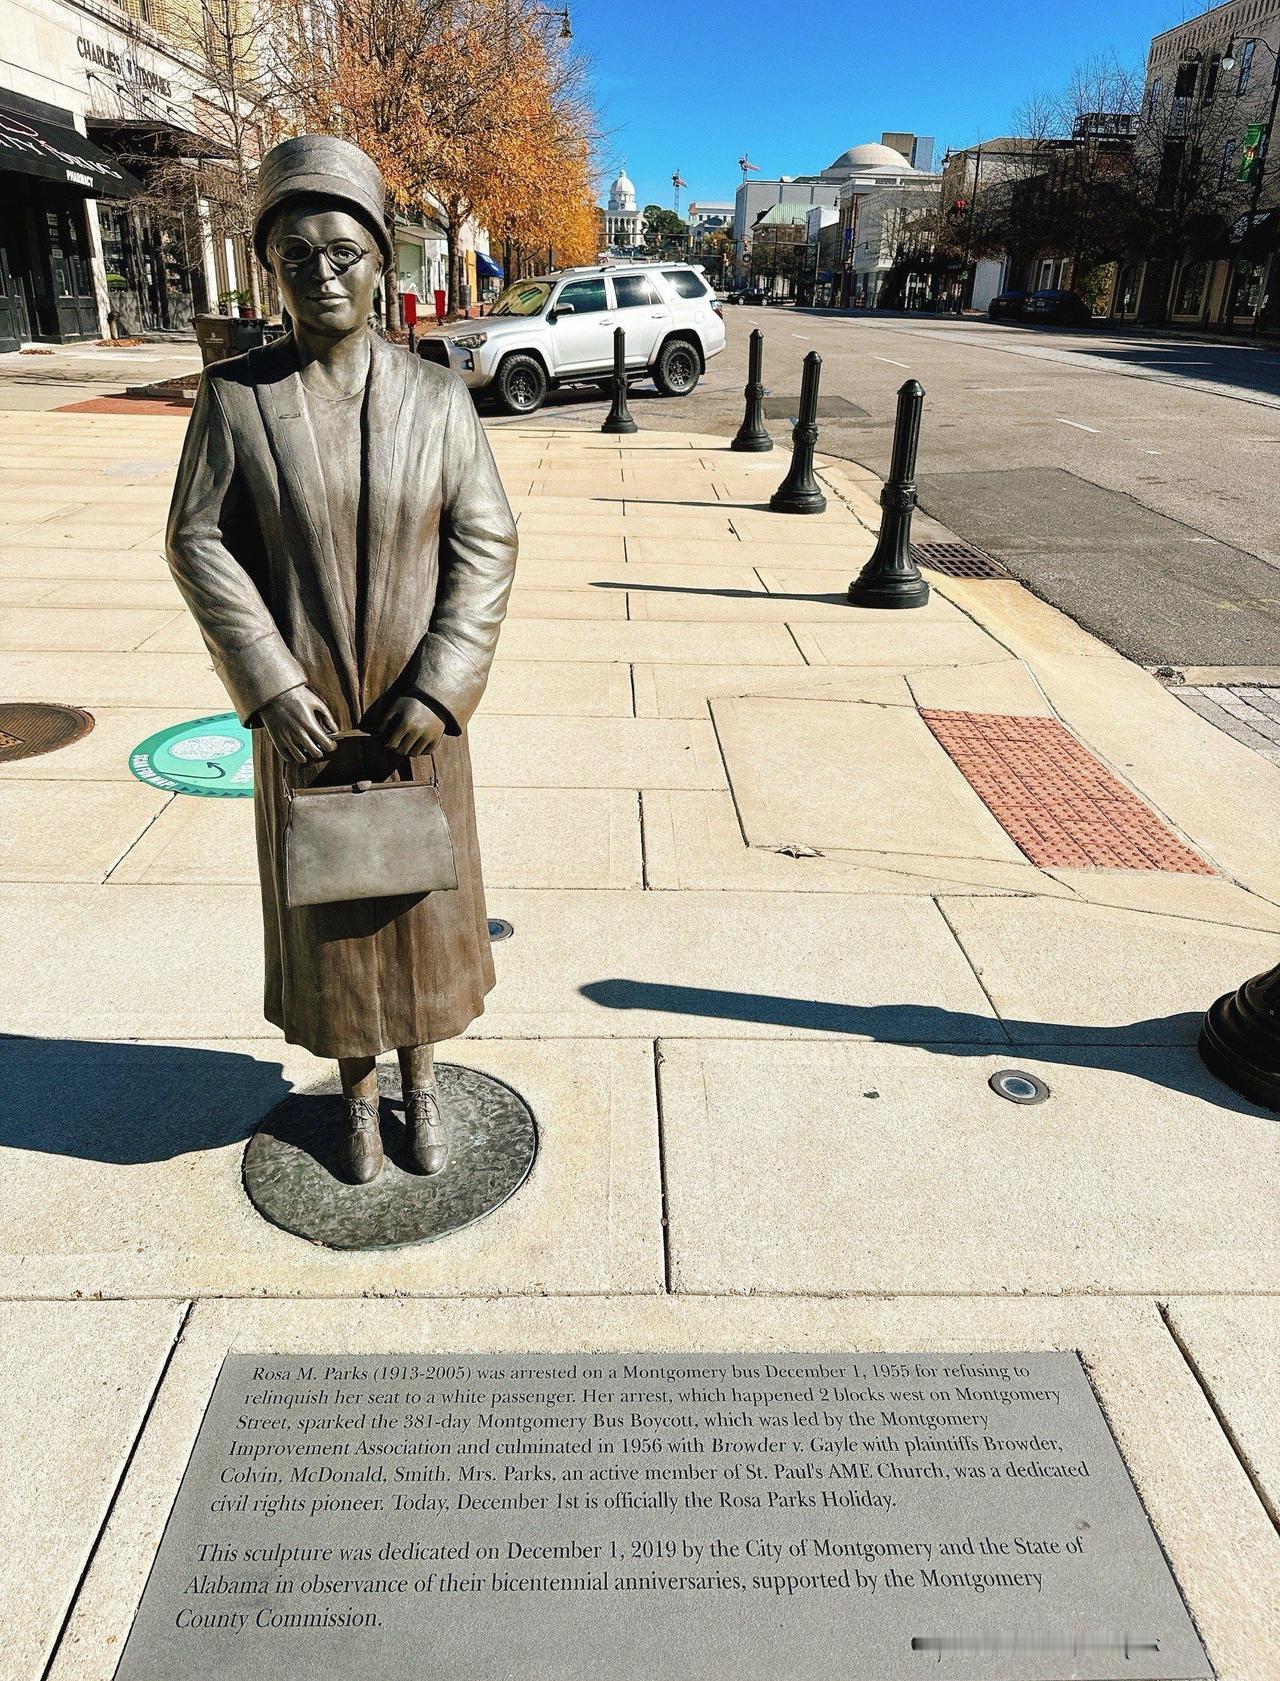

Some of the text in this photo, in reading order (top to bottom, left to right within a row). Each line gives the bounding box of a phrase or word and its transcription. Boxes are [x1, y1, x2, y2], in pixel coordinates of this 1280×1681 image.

[250, 1362, 1030, 1384] Rosa M. Parks (1913-2005) was arrested on a Montgomery bus December 1, 1955 for refusing to
[243, 1386, 1060, 1409] relinquish her seat to a white passenger. Her arrest, which happened 2 blocks west on Montgomery
[235, 1410, 988, 1434] Street, sparked the 381-day Montgomery Bus Boycott, which was led by the Montgomery
[227, 1434, 1063, 1461] Improvement Association and culminated in 1956 with Browder v. Gayle with plaintiffs Browder,
[219, 1460, 1091, 1486] Colvin, McDonald, Smith. Mrs. Parks, an active member of St. Paul's AME Church, was a dedicated
[209, 1489, 897, 1516] civil rights pioneer. Today, December 1st is officially the Rosa Parks Holiday.
[196, 1535, 1086, 1566] This sculpture was dedicated on December 1, 2019 by the City of Montgomery and the State of
[182, 1567, 1042, 1596] Alabama in observance of their bicentennial anniversaries, supported by the Montgomery
[174, 1606, 383, 1635] County Commission.
